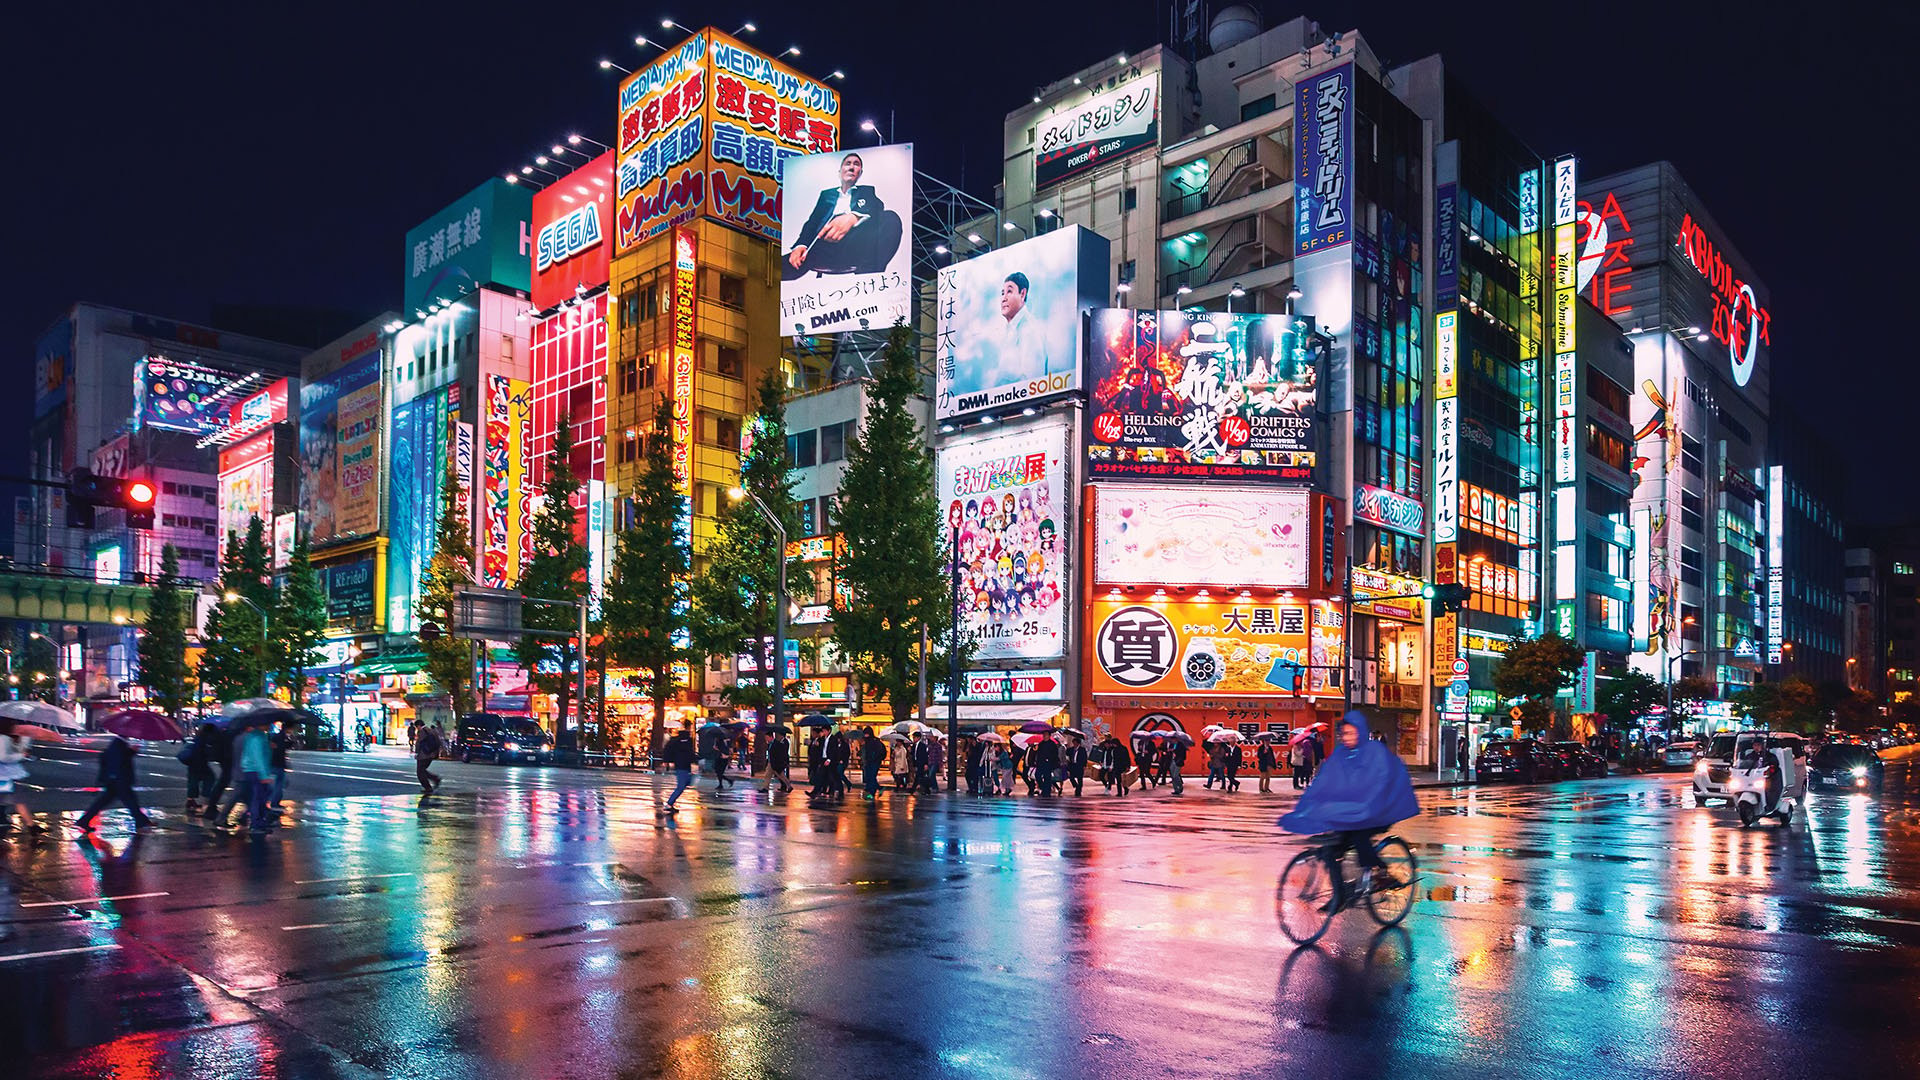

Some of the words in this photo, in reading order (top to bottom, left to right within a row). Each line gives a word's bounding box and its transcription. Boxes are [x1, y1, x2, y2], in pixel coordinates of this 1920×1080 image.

[621, 71, 704, 153] 激安販売
[716, 75, 836, 152] 激安販売
[1042, 87, 1151, 153] メイドカジノ
[619, 115, 702, 199] 高額買取
[1067, 152, 1089, 168] POKER
[1098, 139, 1121, 157] STARS
[619, 170, 704, 247] Mulan
[724, 210, 763, 231] ムーラン
[413, 207, 481, 278] 廣瀬無線
[537, 207, 599, 269] SEGA
[1366, 254, 1379, 279] 7F
[1559, 252, 1568, 285] Yellow
[781, 272, 908, 318] 冒険しつづけよう。
[811, 303, 879, 329] DMM.com
[1440, 317, 1453, 327] 3F
[1558, 293, 1569, 348] Submarine
[938, 270, 957, 417] 次は太陽か。
[1560, 354, 1571, 362] 5F
[958, 387, 1028, 412] DMM.make
[1028, 371, 1072, 397] solar
[1098, 415, 1121, 440] 11/28
[1124, 414, 1182, 427] HELLSING
[1124, 426, 1149, 436] OVA
[1225, 417, 1248, 443] 11/30
[1250, 427, 1296, 438] COMICS
[1297, 428, 1305, 438] 6
[1251, 416, 1311, 429] DRIFTERS
[1355, 487, 1423, 531] メイドカジノ
[1183, 624, 1217, 635] チケット
[1223, 607, 1304, 635] 大黒屋
[1108, 619, 1166, 676] 質
[1406, 641, 1414, 677] ルノアール
[1446, 628, 1454, 661] FREE
[1455, 663, 1465, 671] 40
[971, 679, 1013, 693] COM
[1016, 678, 1035, 692] ZIN
[1227, 709, 1272, 719] チケット
